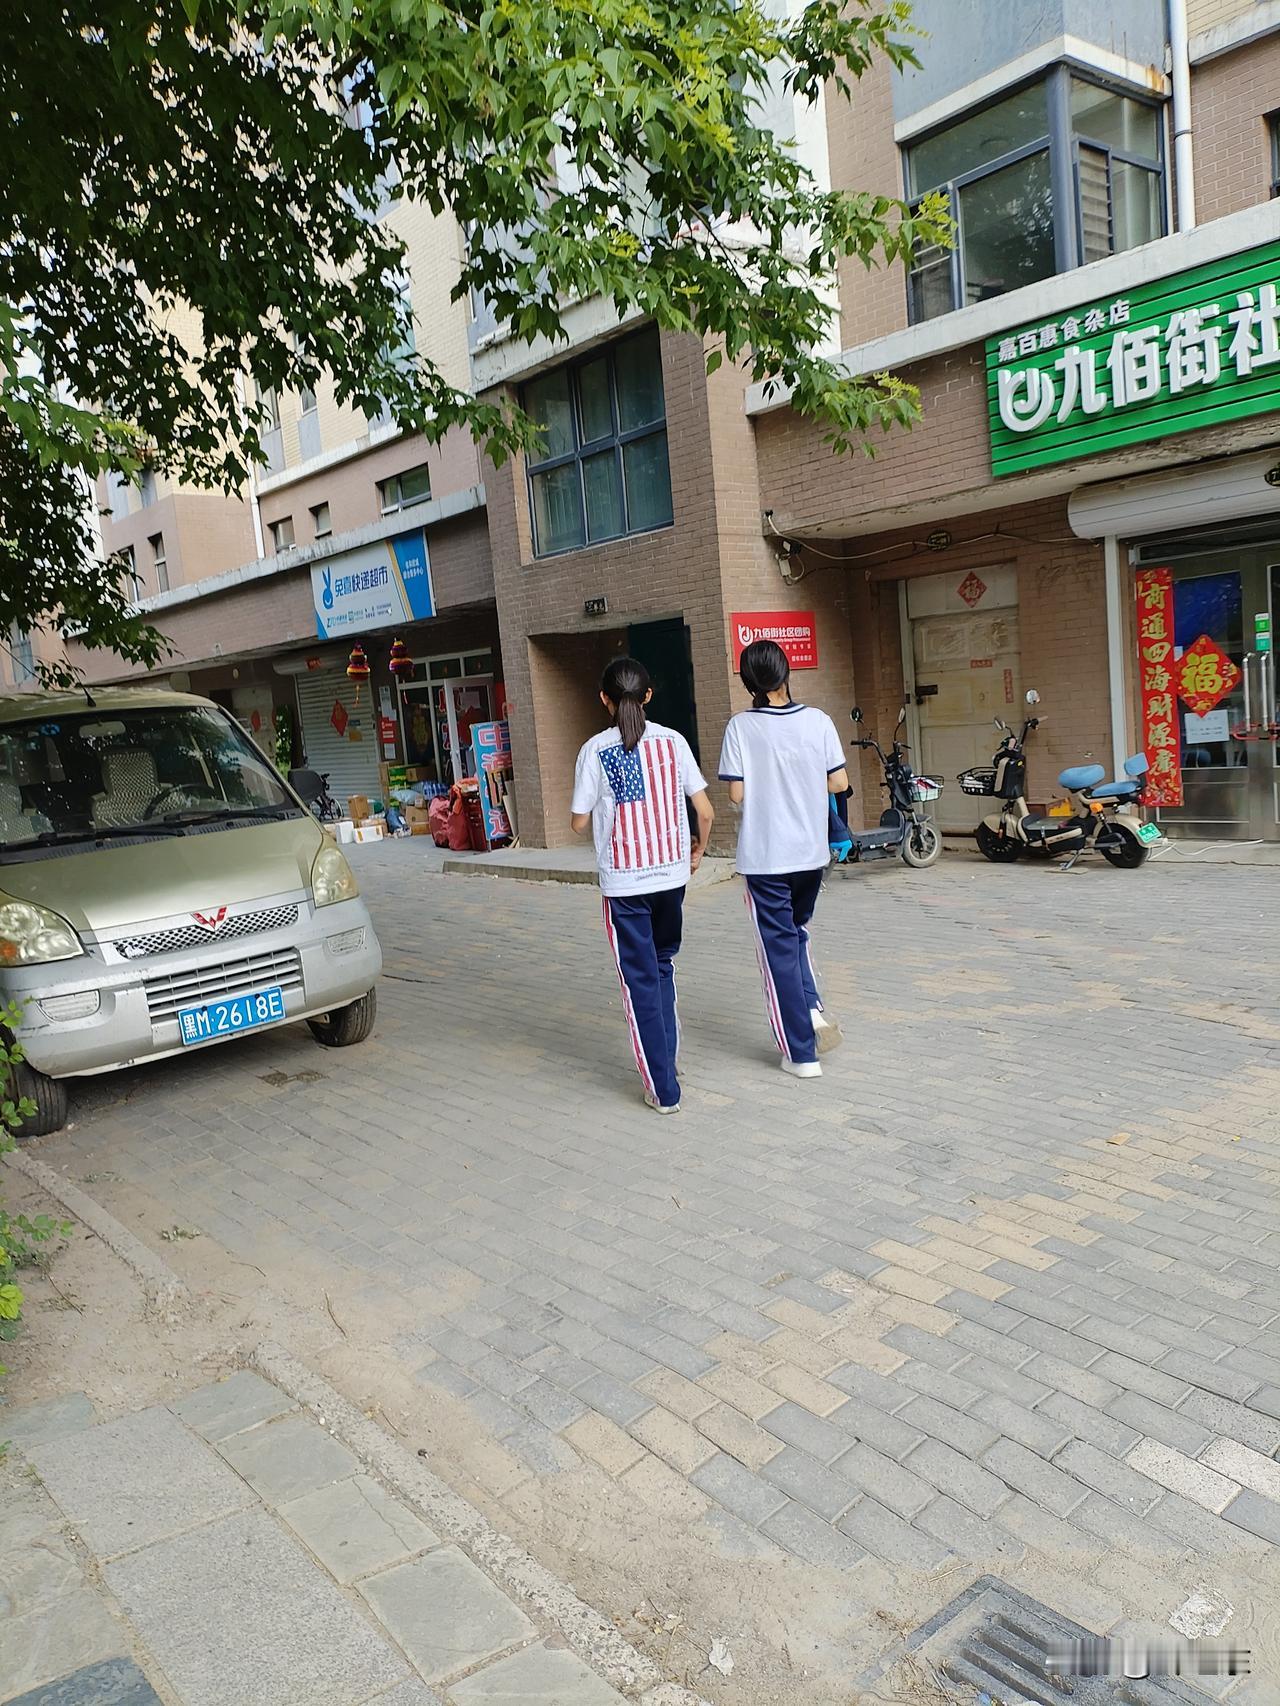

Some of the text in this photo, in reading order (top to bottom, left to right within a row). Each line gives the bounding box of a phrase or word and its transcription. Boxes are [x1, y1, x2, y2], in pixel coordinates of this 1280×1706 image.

[998, 299, 1130, 362] 嘉百惠食杂店
[753, 626, 811, 639] 九佰街社区团购
[1181, 652, 1224, 695] 福
